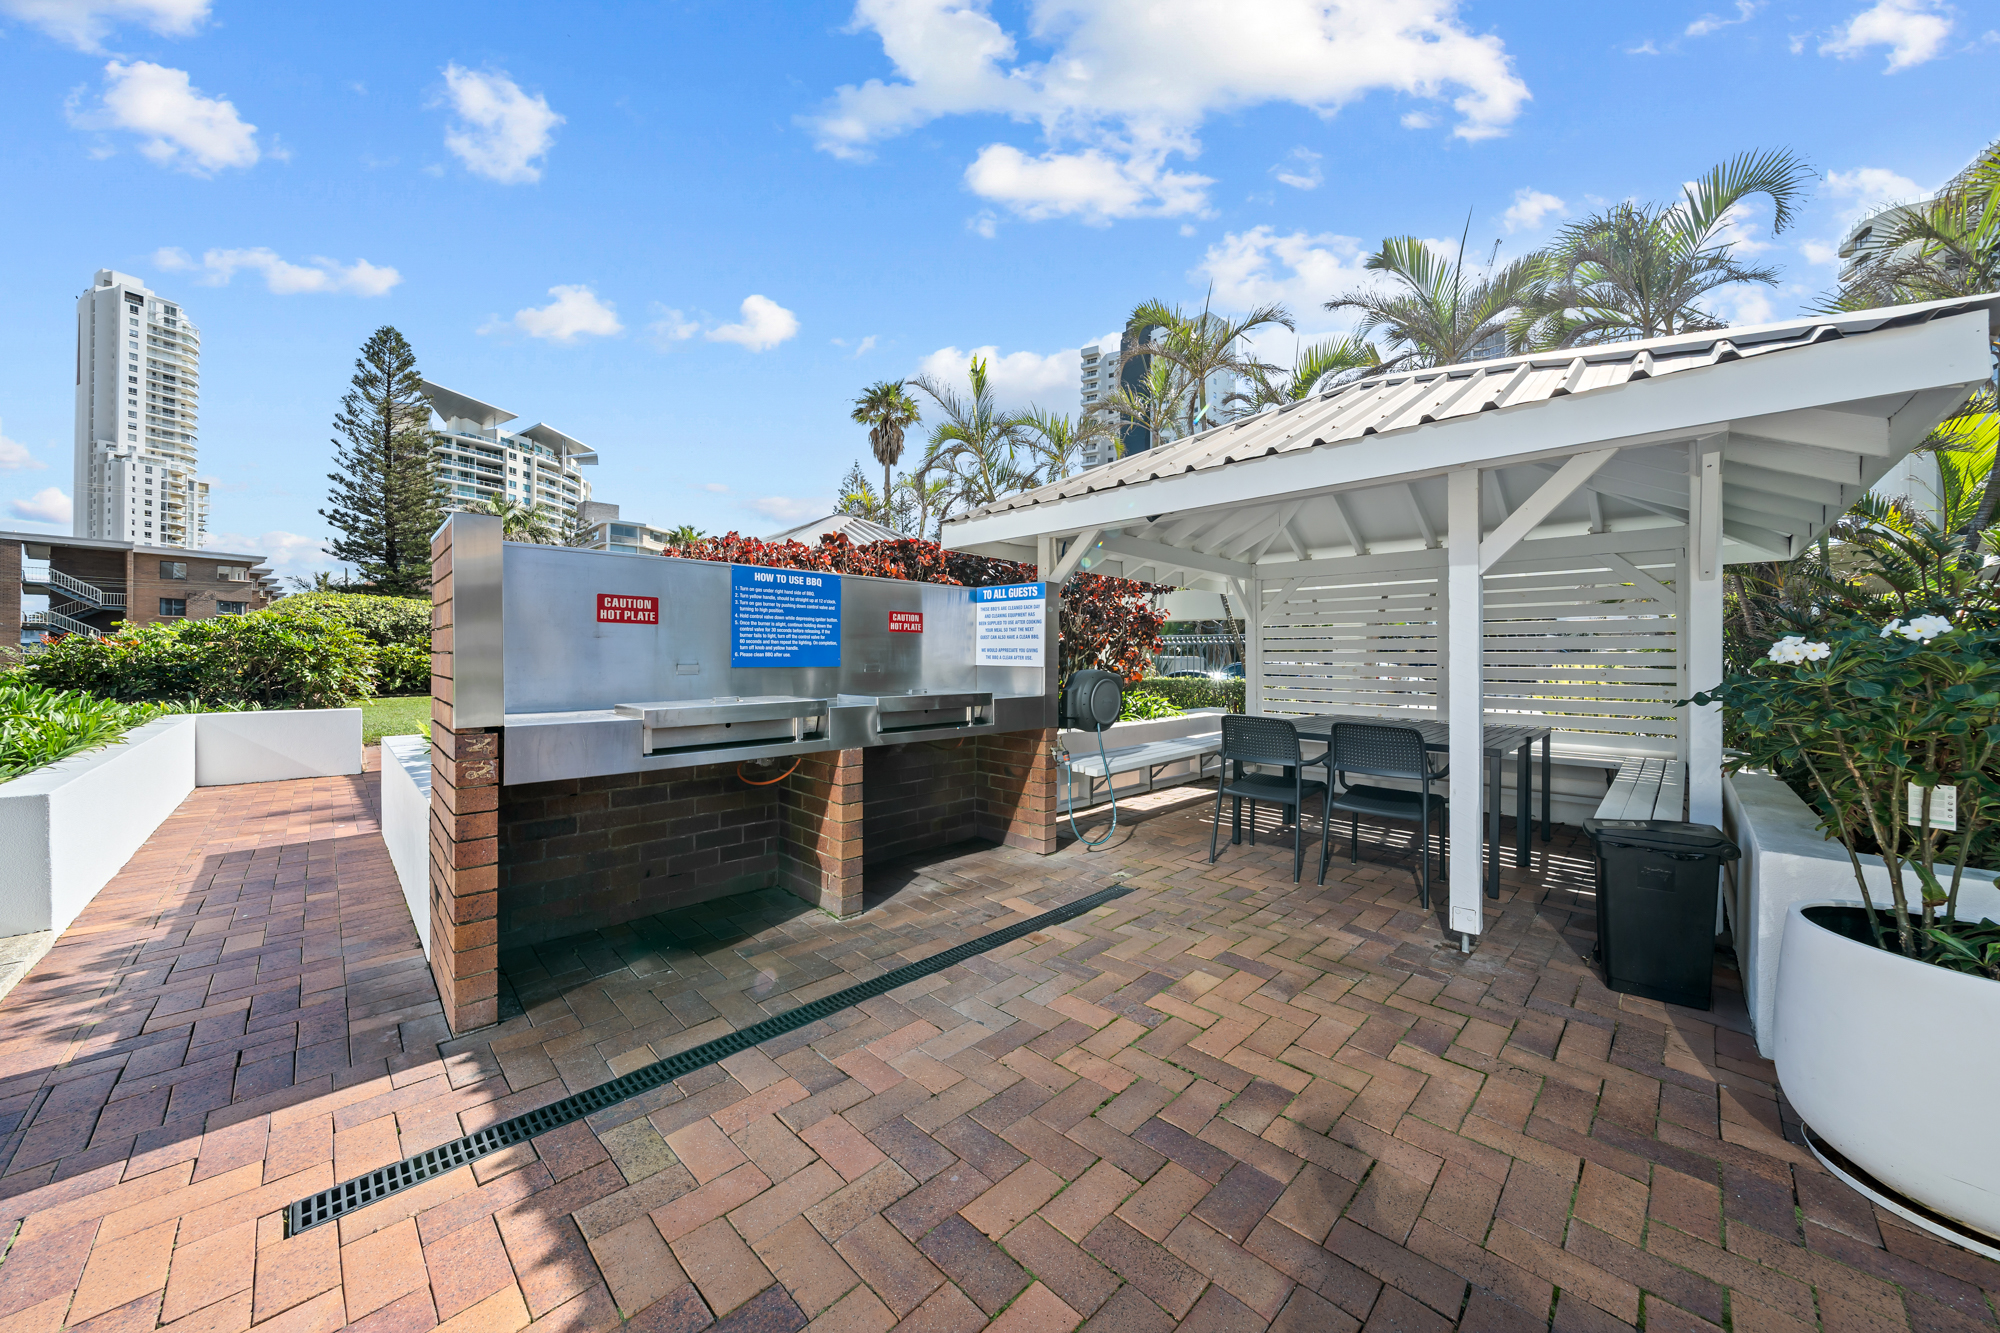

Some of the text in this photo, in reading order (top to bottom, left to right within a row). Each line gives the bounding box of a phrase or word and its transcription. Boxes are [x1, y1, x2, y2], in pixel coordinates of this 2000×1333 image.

[755, 572, 822, 587] HOW TO USE BBQ
[983, 586, 1038, 599] TO ALL GUESTS
[604, 597, 651, 609] CAUTION
[600, 610, 655, 621] HOT PLATE
[893, 613, 919, 622] CAUTION
[904, 623, 921, 631] PLATE
